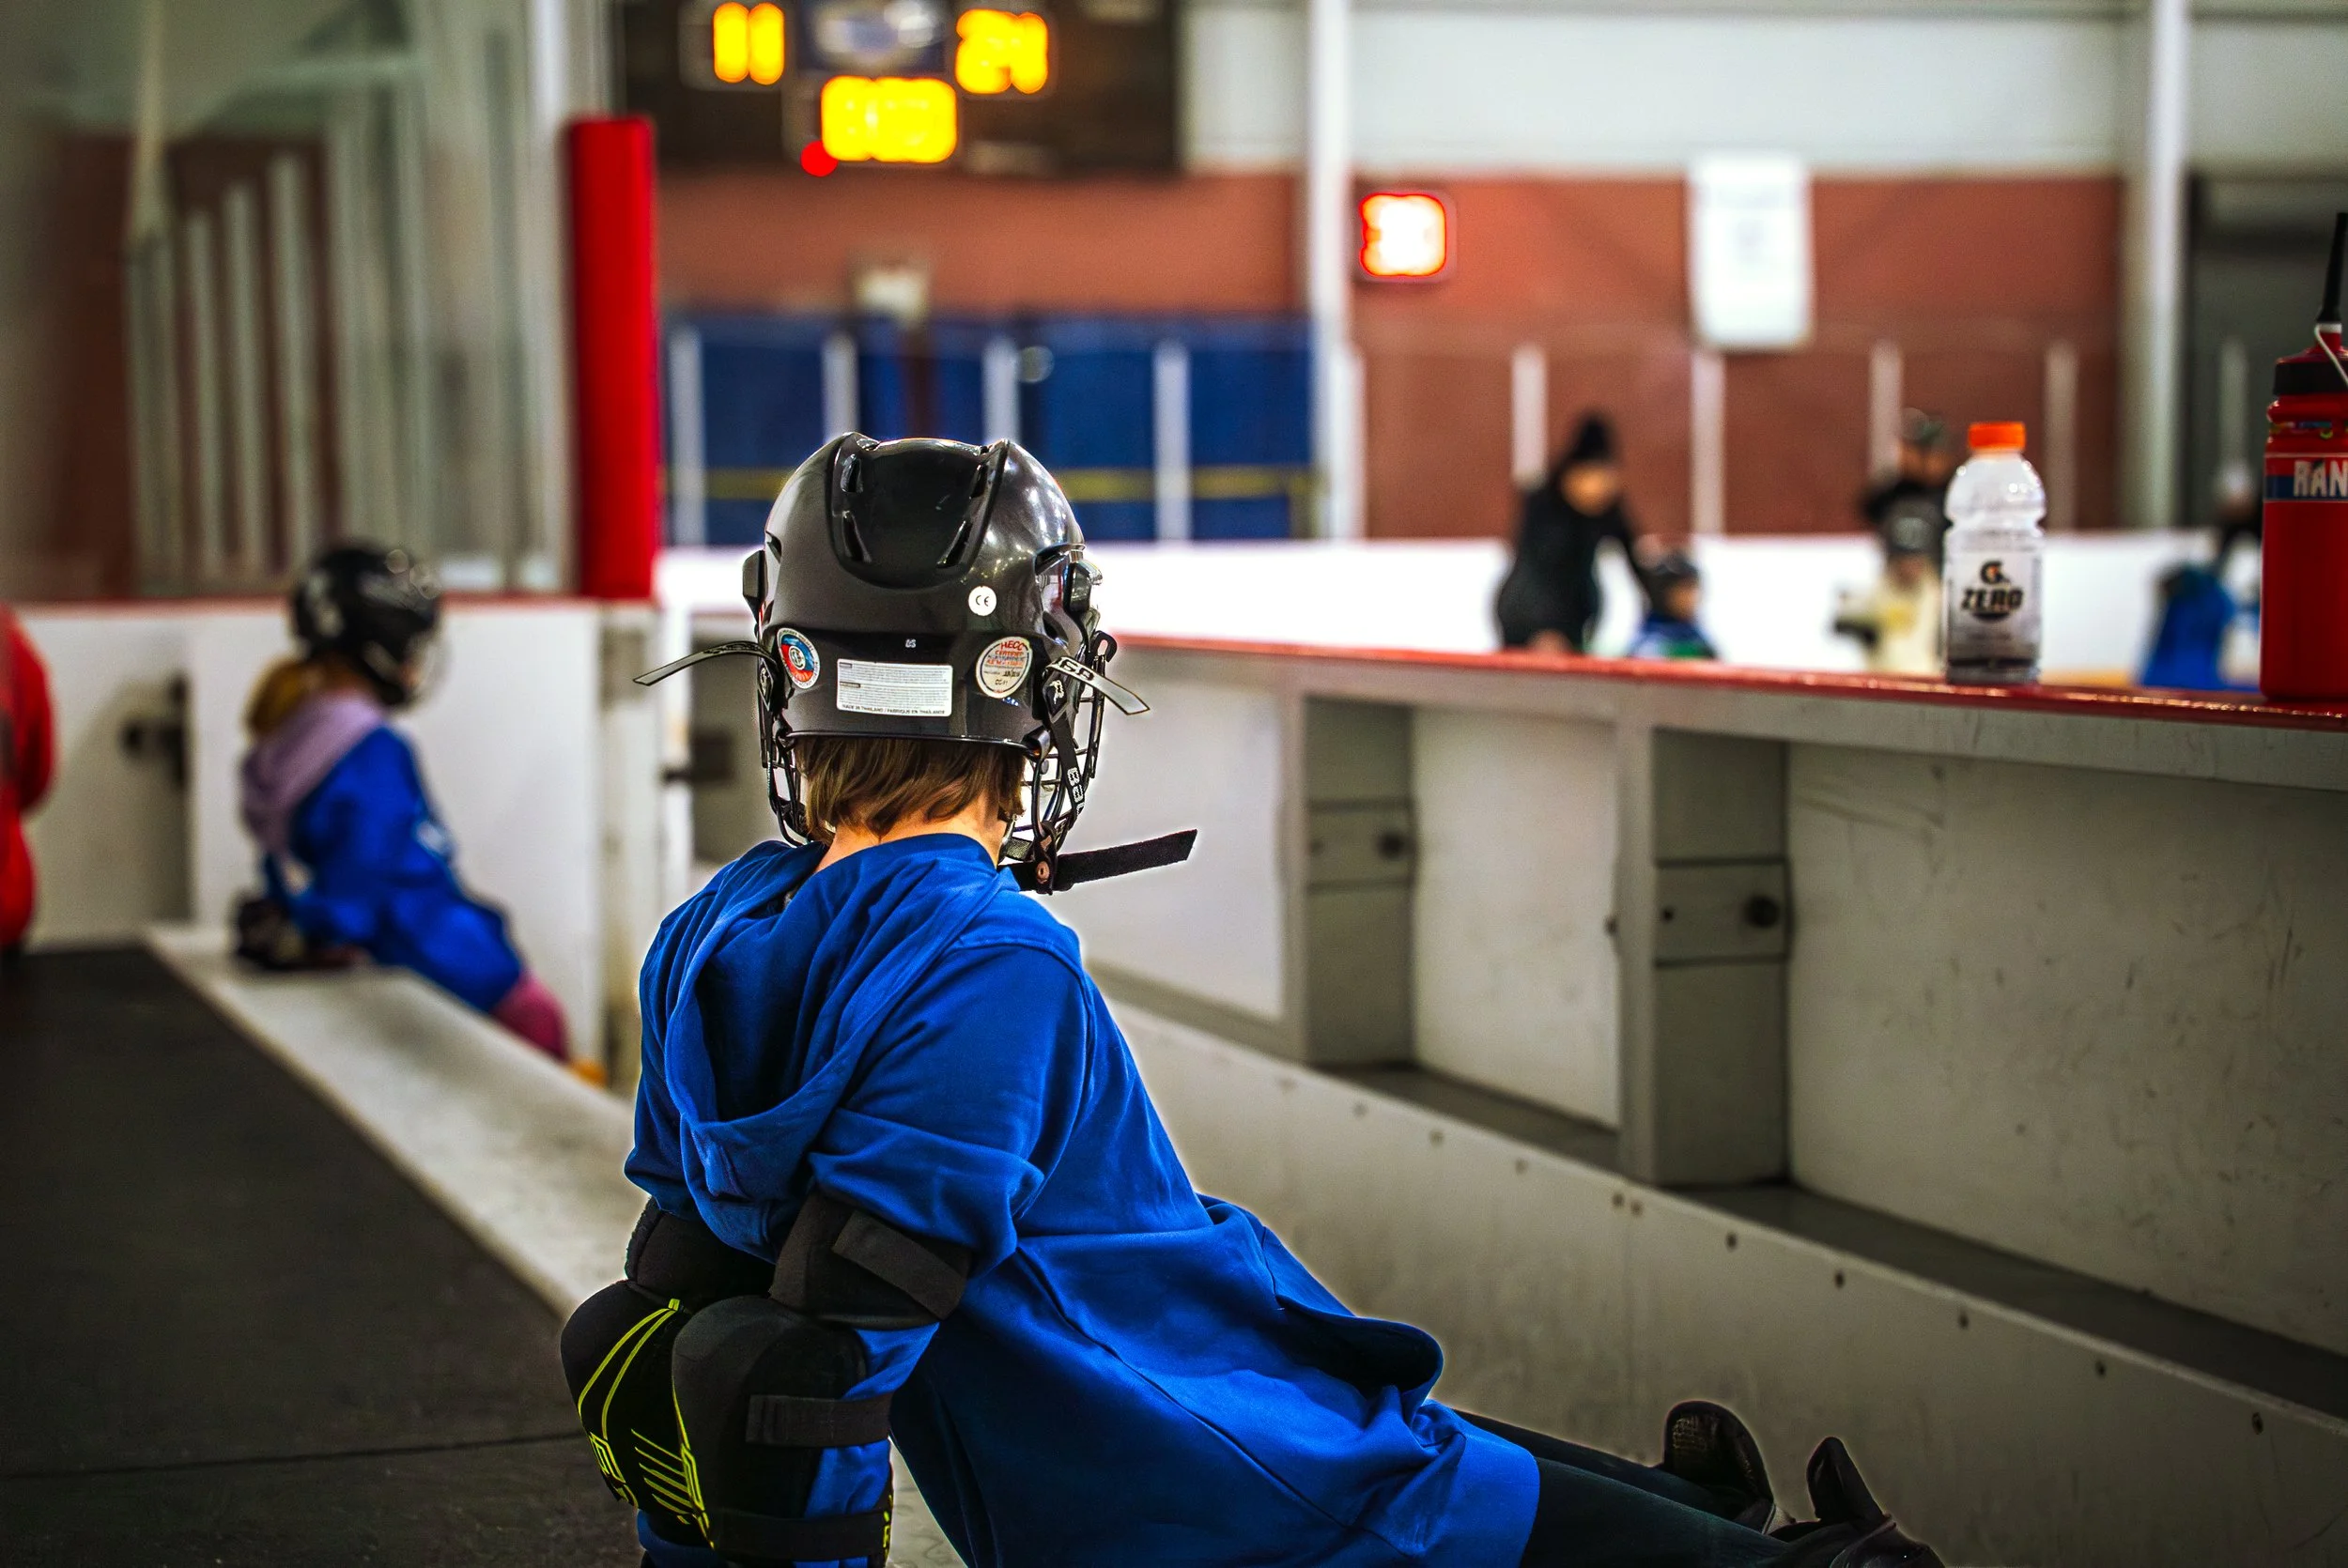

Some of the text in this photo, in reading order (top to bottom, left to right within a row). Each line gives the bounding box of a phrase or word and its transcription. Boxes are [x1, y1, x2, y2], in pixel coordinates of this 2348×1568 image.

[2294, 459, 2348, 498] RAN
[975, 594, 990, 607] CE
[1961, 589, 2023, 610] ZERO
[1000, 640, 1025, 651] HECC
